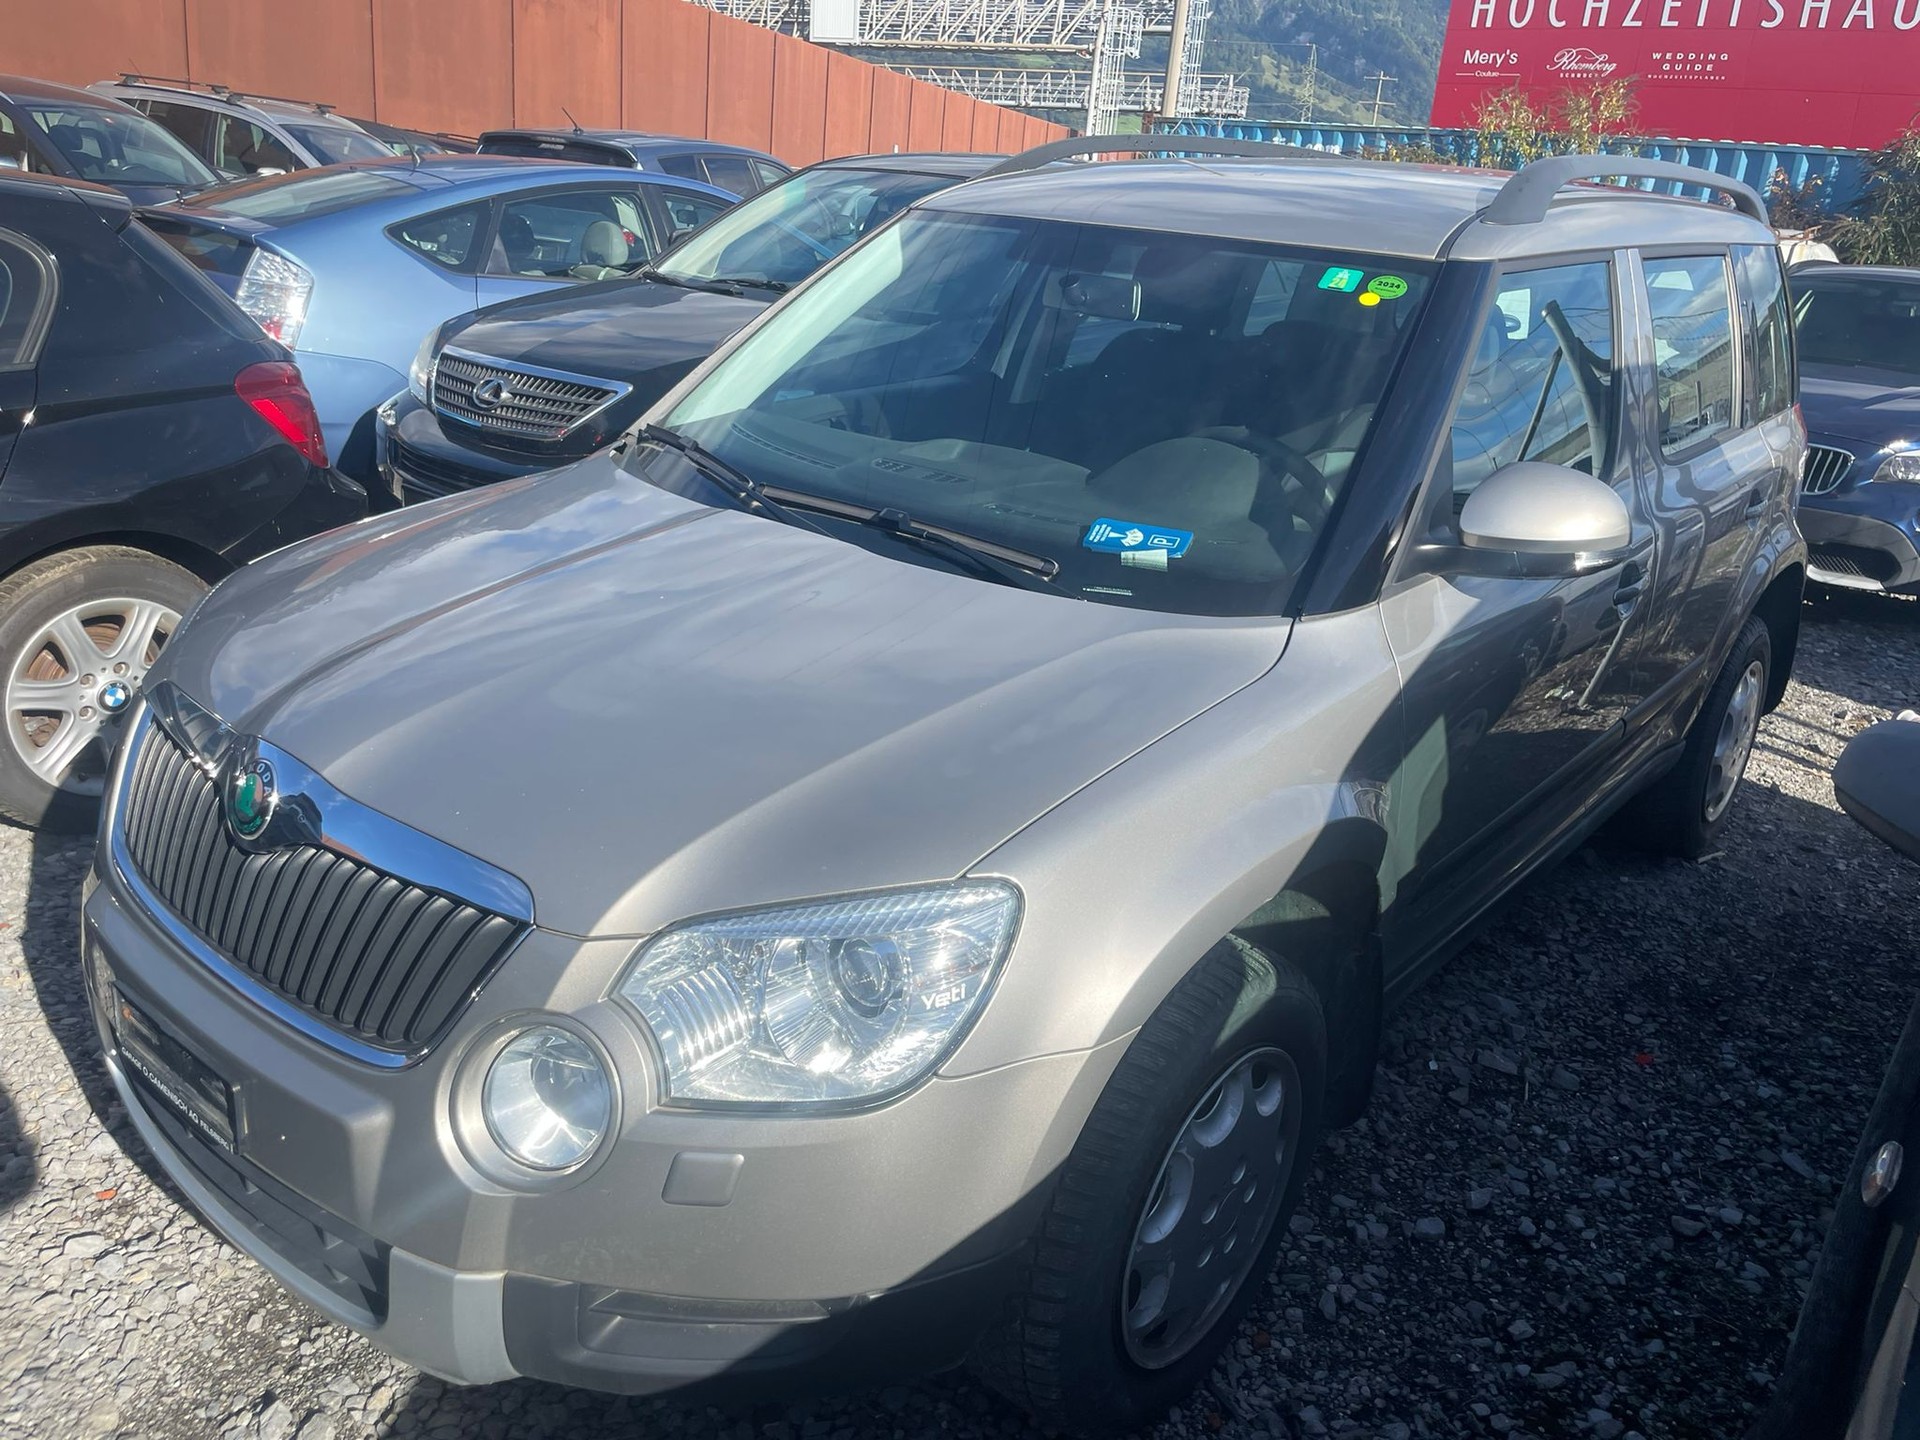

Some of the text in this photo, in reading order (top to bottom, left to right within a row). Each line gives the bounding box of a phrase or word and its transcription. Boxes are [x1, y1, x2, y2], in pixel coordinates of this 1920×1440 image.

[1463, 49, 1519, 68] Mery's
[1546, 47, 1618, 78] Rhomberg
[1652, 52, 1729, 61] WEDDING
[1662, 63, 1714, 72] GUIDE
[1376, 280, 1401, 290] 2024
[920, 983, 967, 1010] Yeti
[121, 1046, 142, 1070] GARAGE
[188, 1109, 199, 1124] AG
